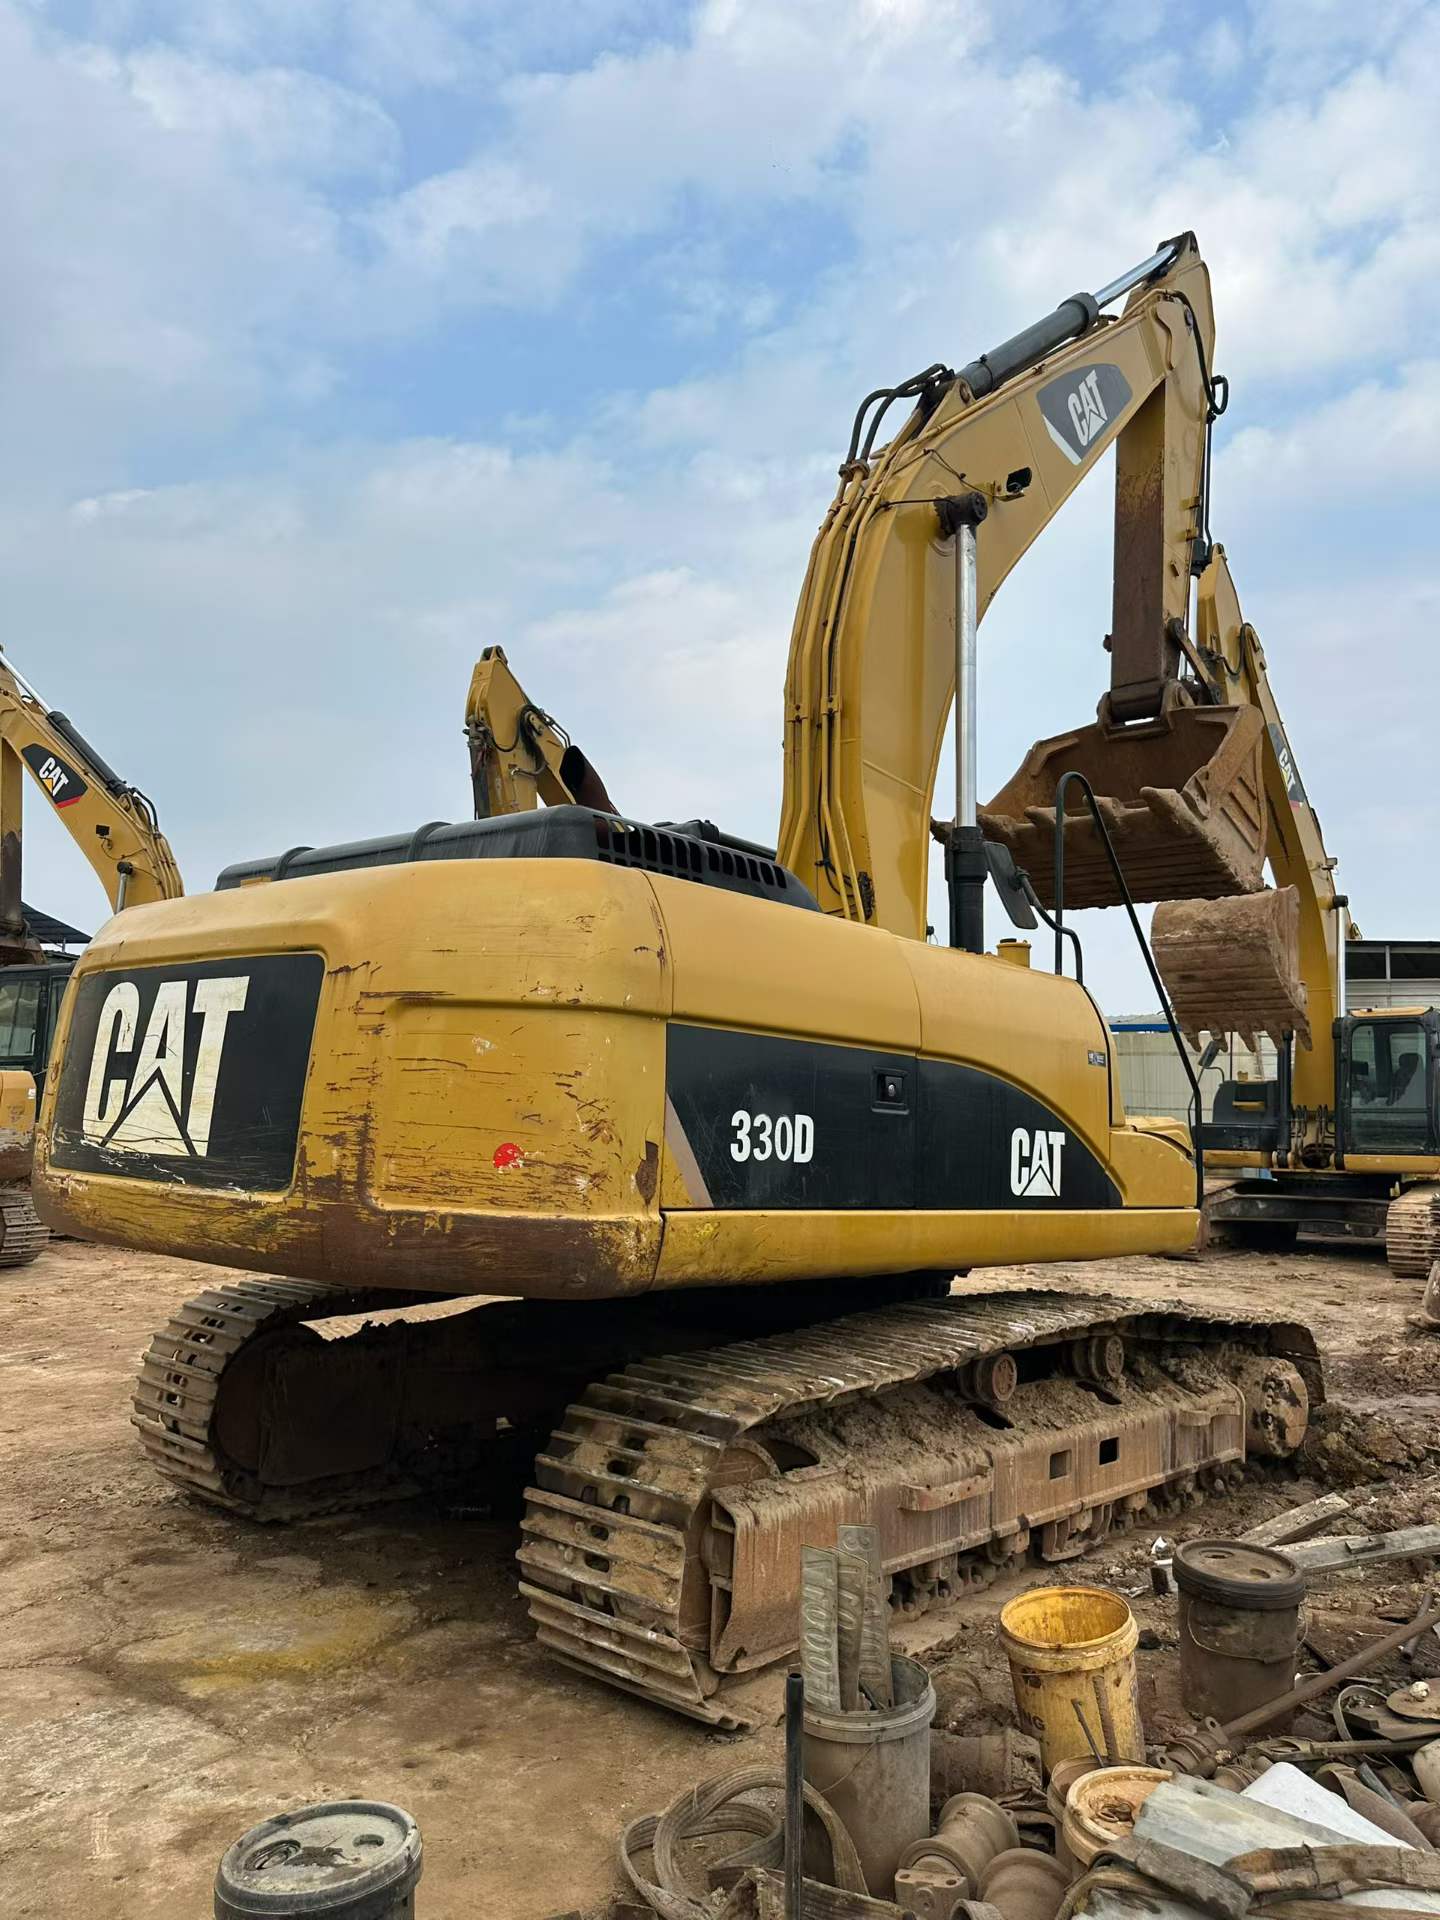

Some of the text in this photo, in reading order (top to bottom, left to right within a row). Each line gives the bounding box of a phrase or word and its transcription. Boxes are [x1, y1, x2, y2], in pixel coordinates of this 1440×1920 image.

[1067, 369, 1109, 447] CAT
[38, 757, 70, 796] CAT
[1279, 748, 1297, 793] CAT
[82, 975, 250, 1158] CAT
[729, 1110, 815, 1164] 330D
[1010, 1127, 1066, 1198] CAT
